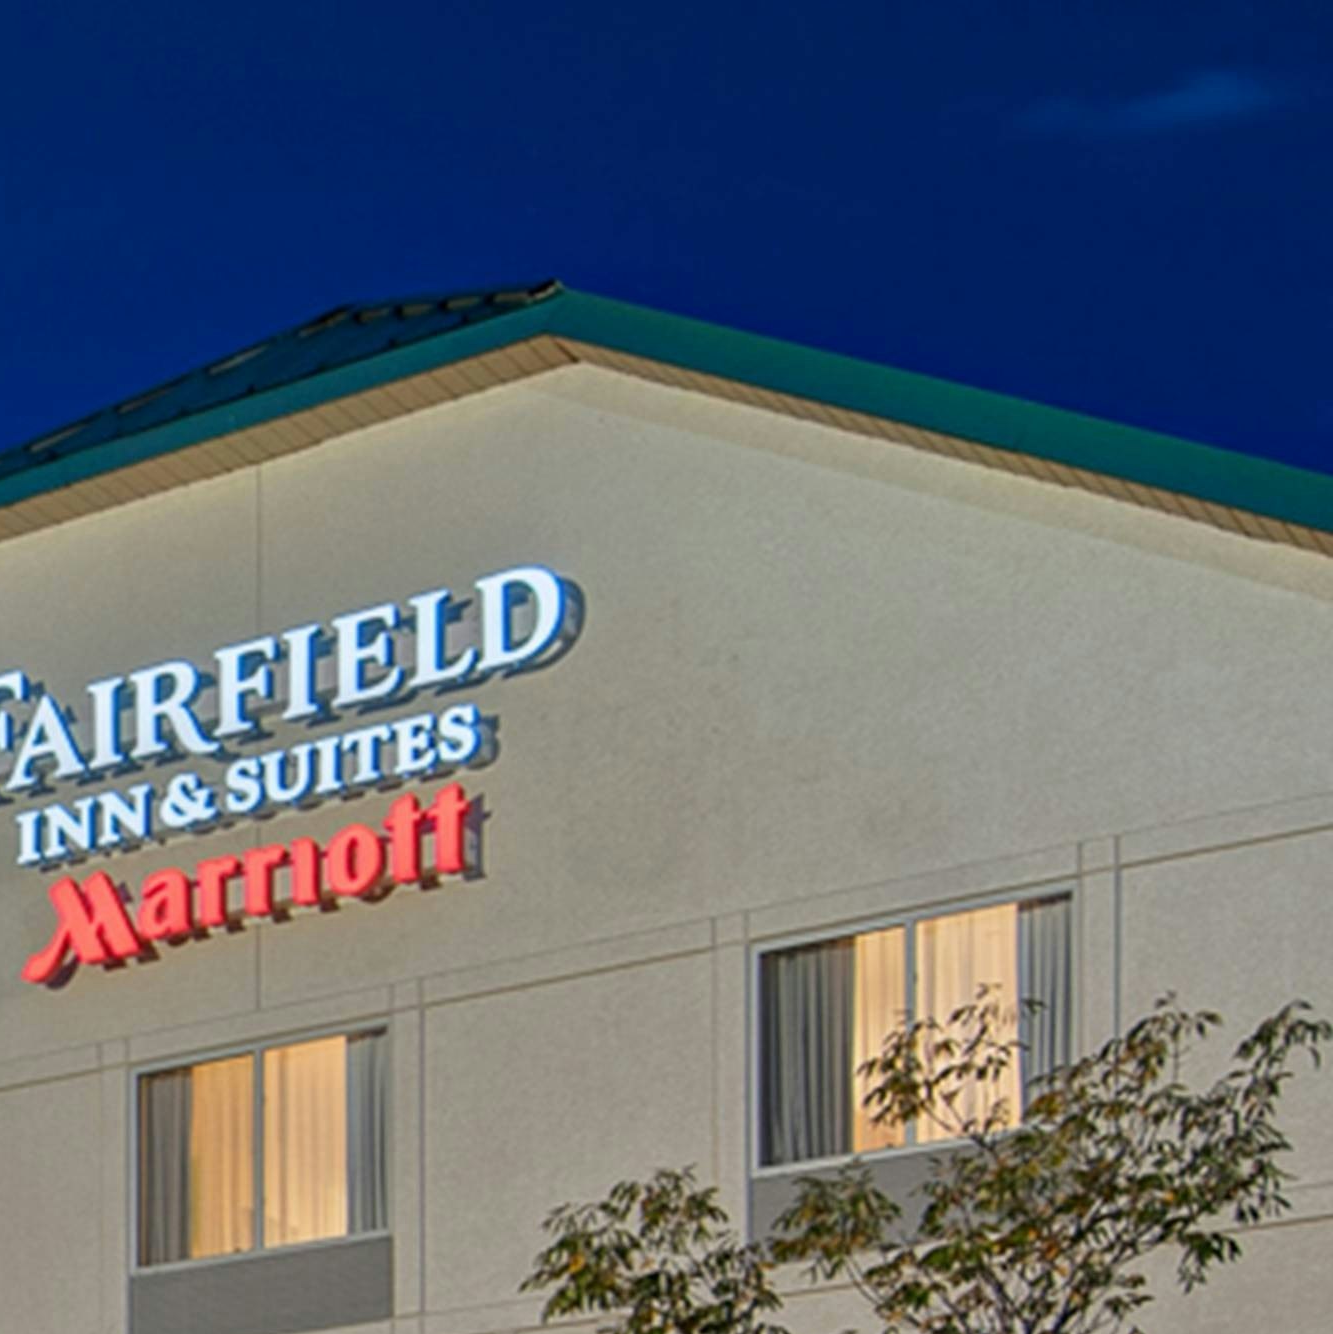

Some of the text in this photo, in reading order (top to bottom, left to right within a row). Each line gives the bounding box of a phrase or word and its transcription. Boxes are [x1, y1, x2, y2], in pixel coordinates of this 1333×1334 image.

[16, 703, 485, 868] INN & SUITES
[20, 781, 471, 984] Marriott
